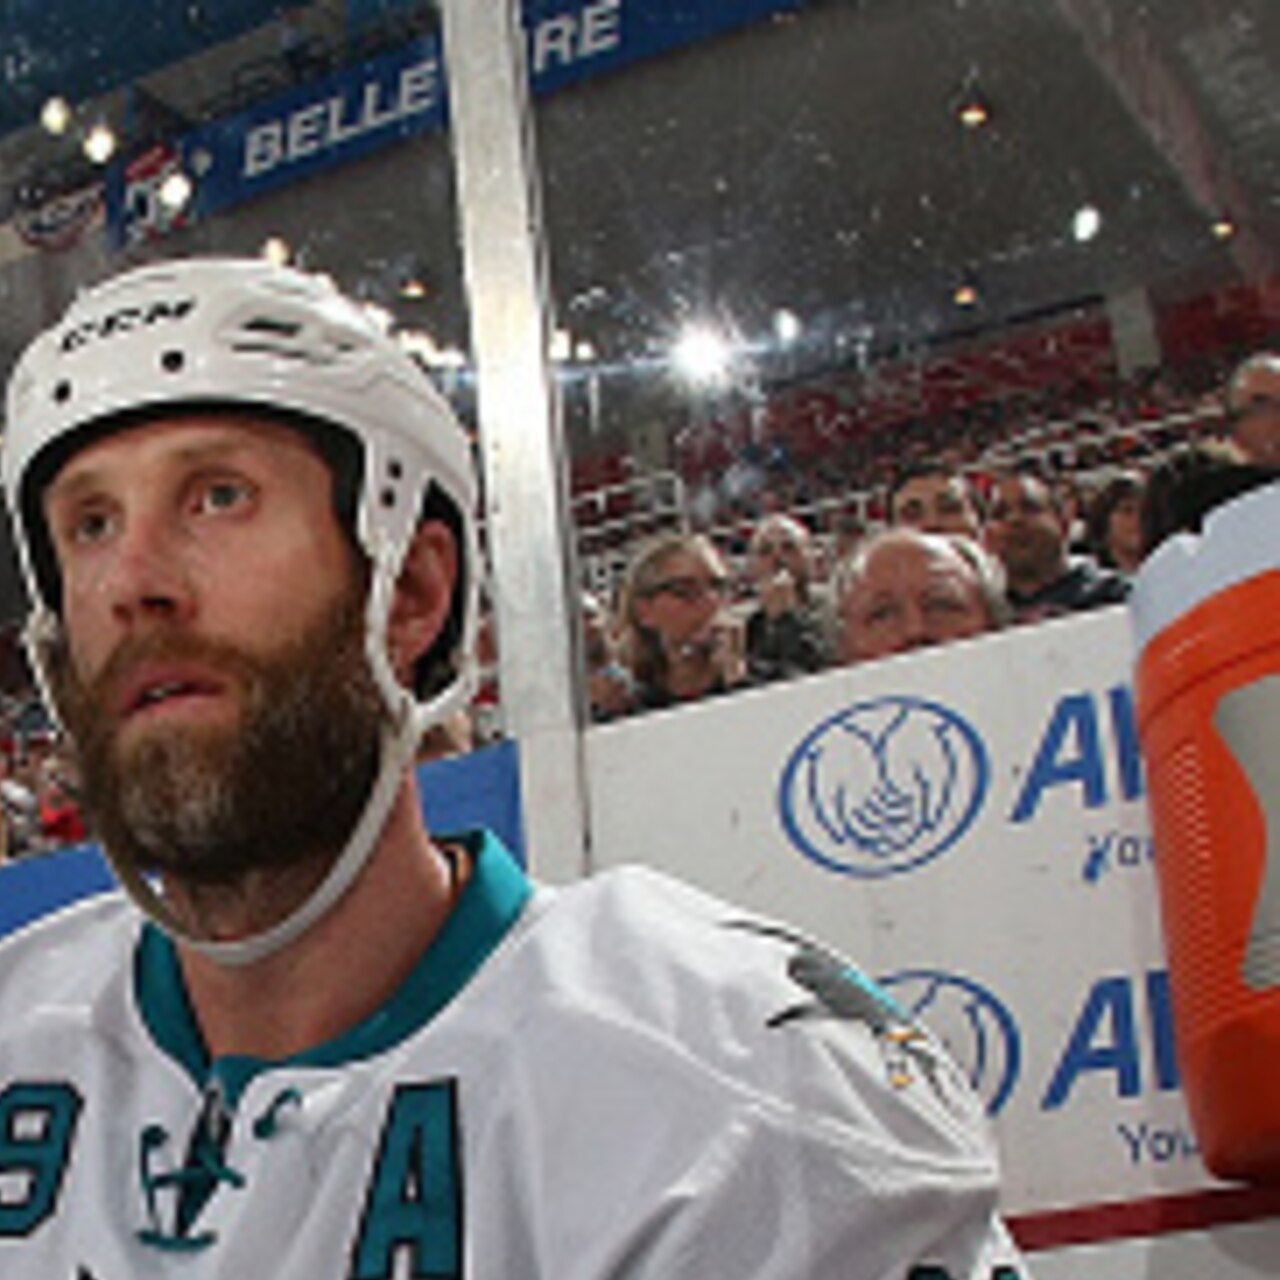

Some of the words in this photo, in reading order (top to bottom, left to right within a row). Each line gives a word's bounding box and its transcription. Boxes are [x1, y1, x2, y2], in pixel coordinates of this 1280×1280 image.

[243, 57, 438, 178] BELLE
[533, 1, 621, 72] RE
[60, 298, 197, 352] CCM
[1008, 682, 1144, 823] Al
[1040, 968, 1183, 1111] Al
